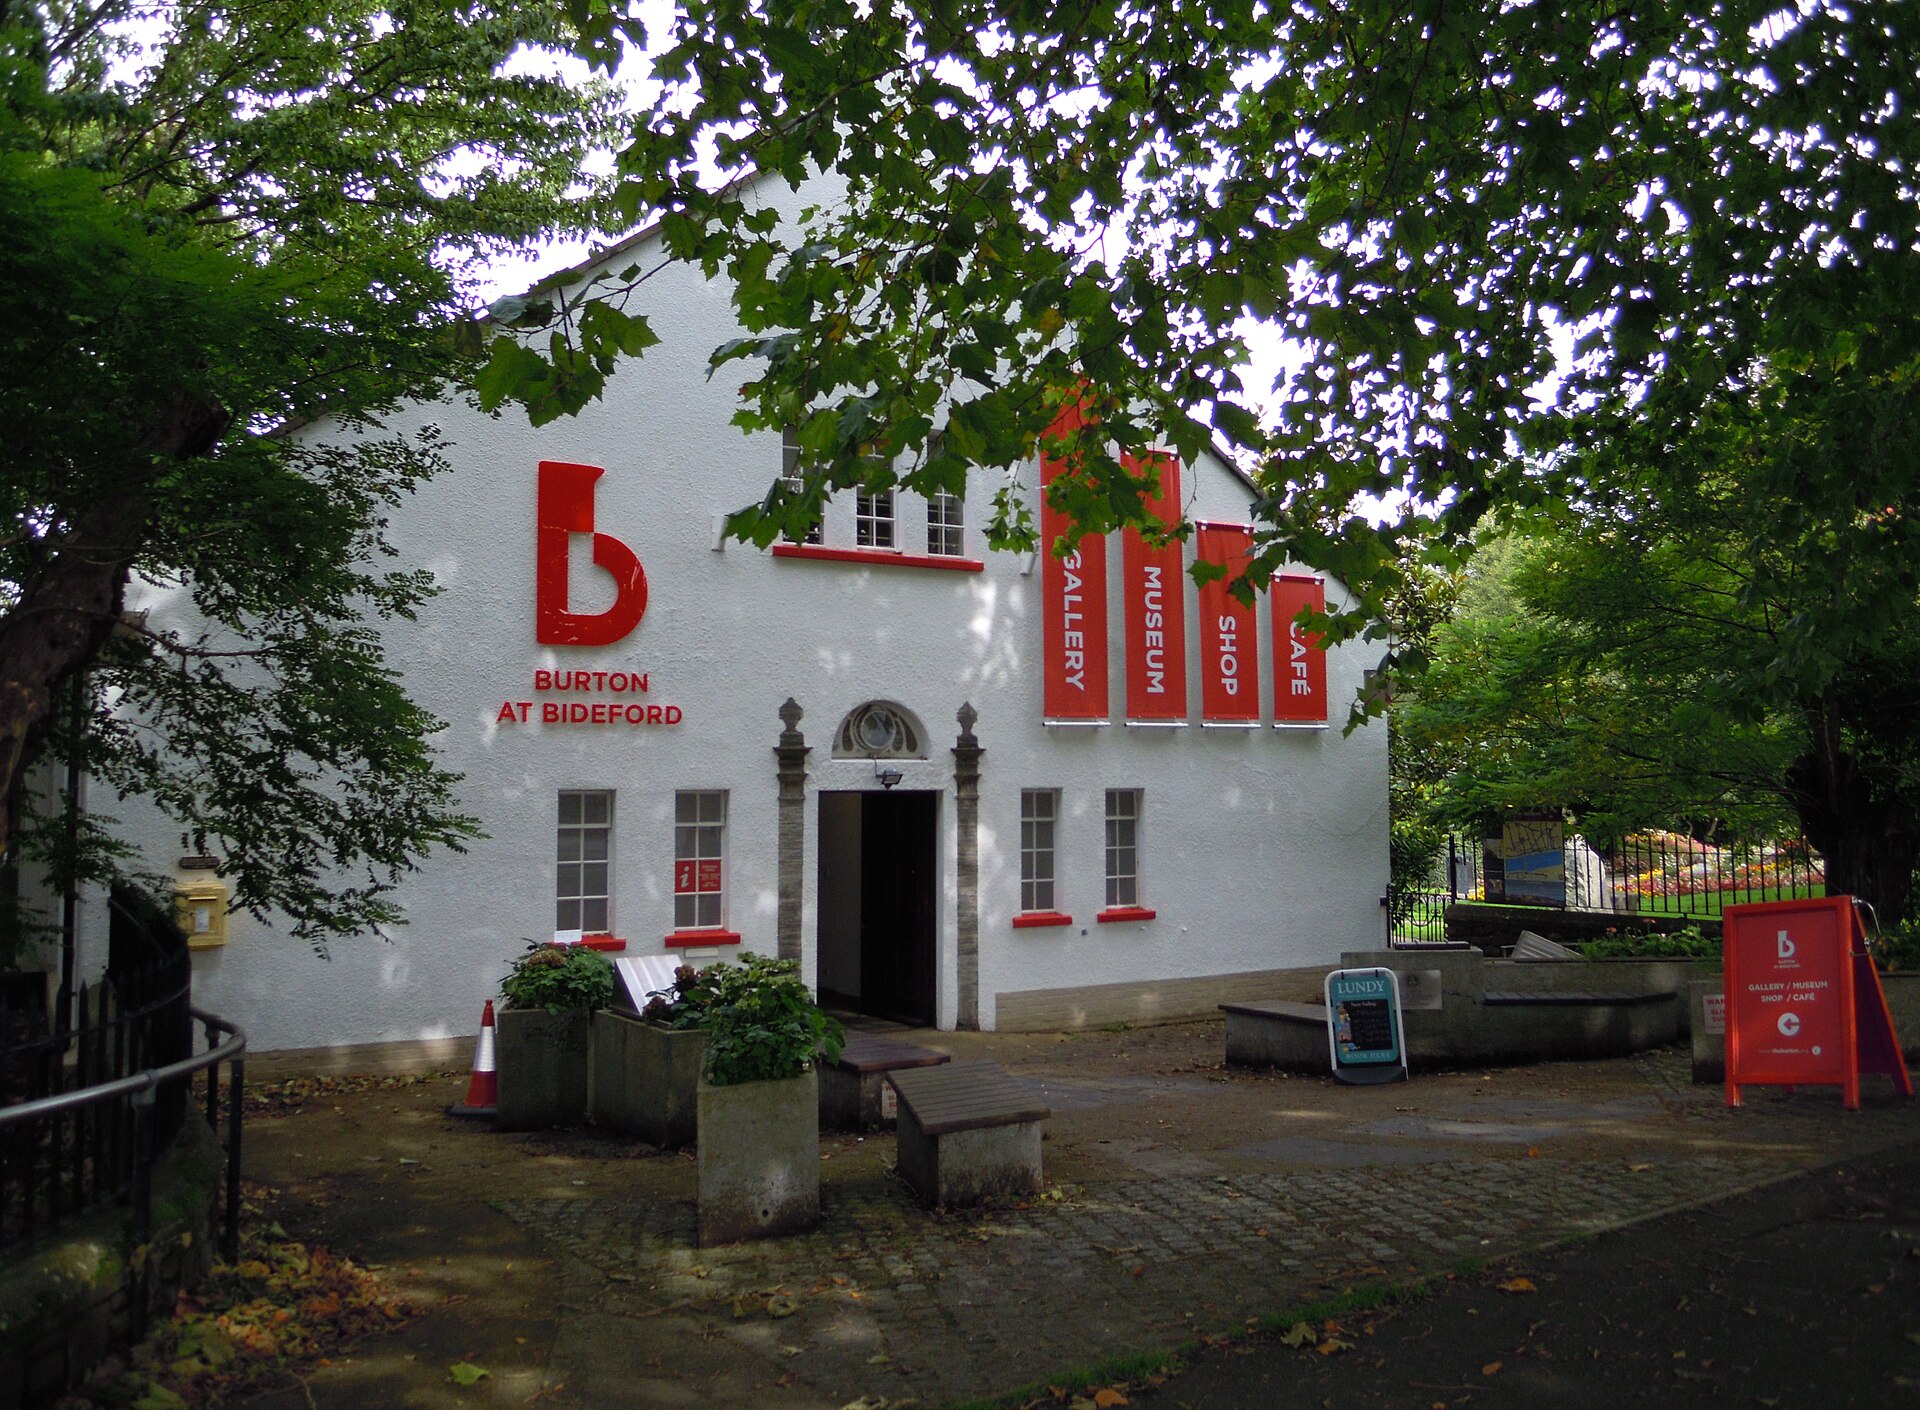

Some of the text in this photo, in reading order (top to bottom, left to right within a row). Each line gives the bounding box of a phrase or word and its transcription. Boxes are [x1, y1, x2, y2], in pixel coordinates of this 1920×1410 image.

[1063, 548, 1085, 691] GALLERY
[1144, 566, 1165, 693] MUSEUM
[1218, 615, 1238, 695] SHOP
[535, 670, 649, 693] BURTON
[497, 701, 683, 725] AT BIDEFORD
[1337, 980, 1385, 993] LUNDY
[1748, 982, 1785, 992] GALLERY
[1792, 980, 1828, 990] MUSEUM
[1760, 994, 1783, 1002] SHOP
[1792, 991, 1815, 1001] CAFÉ
